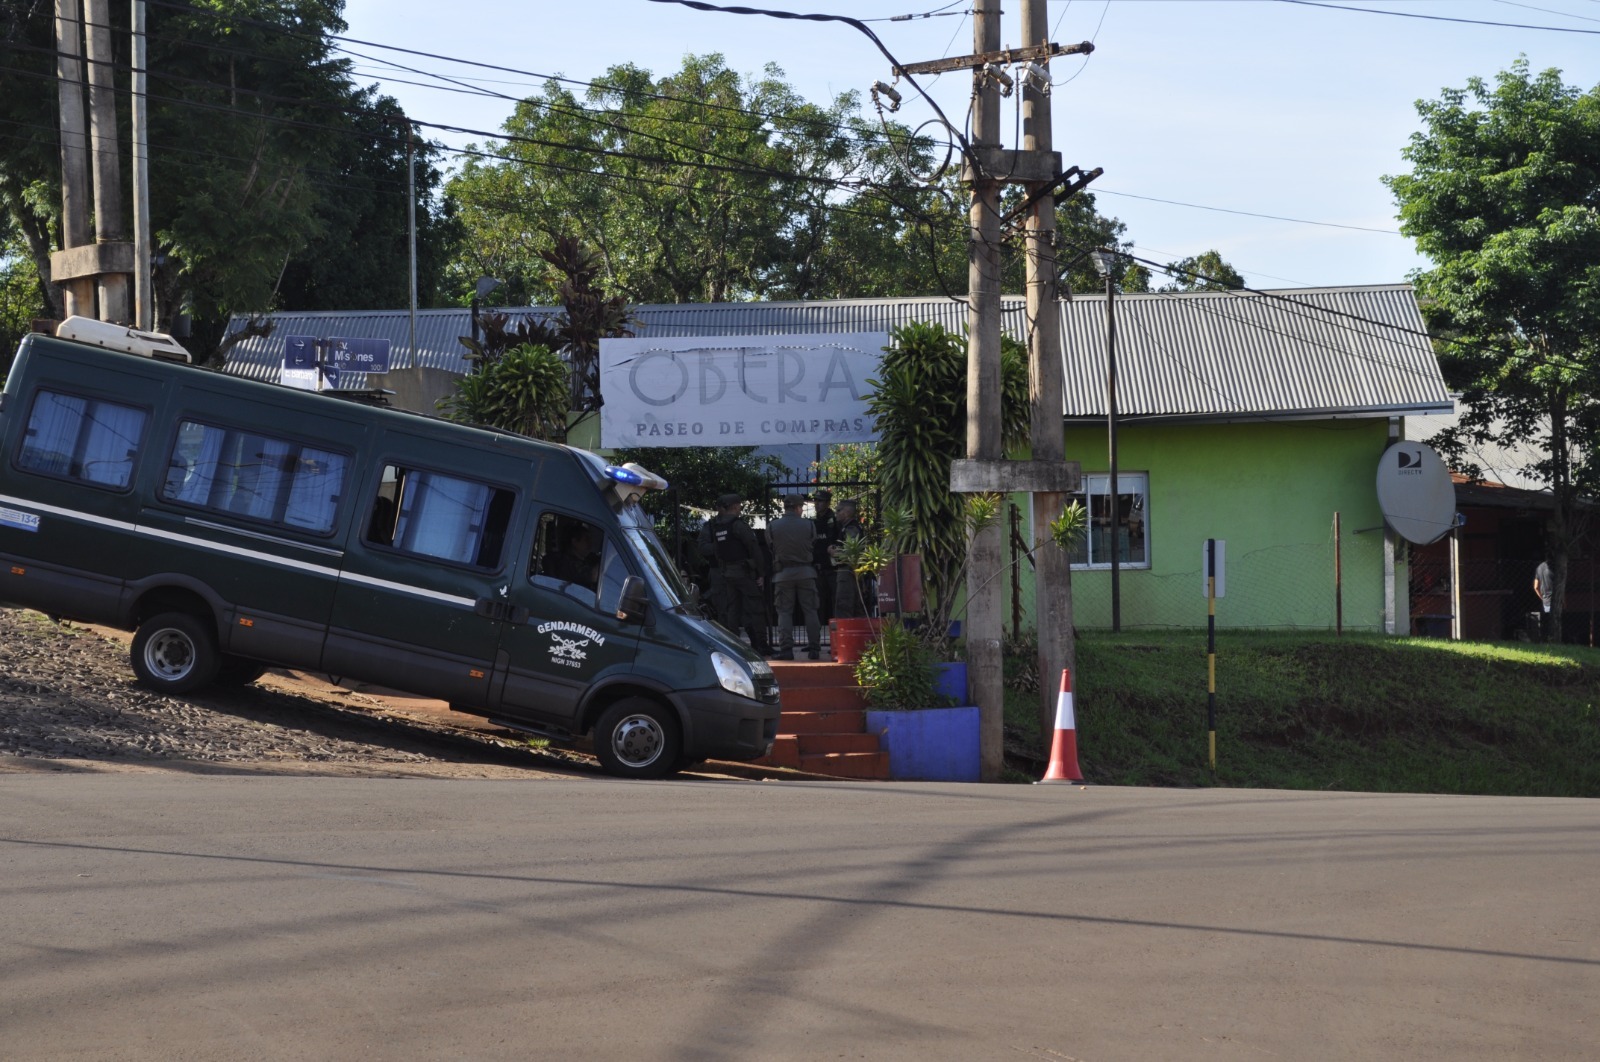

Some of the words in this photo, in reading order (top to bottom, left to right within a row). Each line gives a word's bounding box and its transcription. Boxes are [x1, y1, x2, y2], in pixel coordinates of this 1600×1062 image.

[335, 350, 374, 362] Msones
[636, 422, 704, 436] PASEO
[719, 421, 745, 435] DE
[760, 418, 864, 434] COMPRAS
[537, 621, 606, 647] GENDARMERIA
